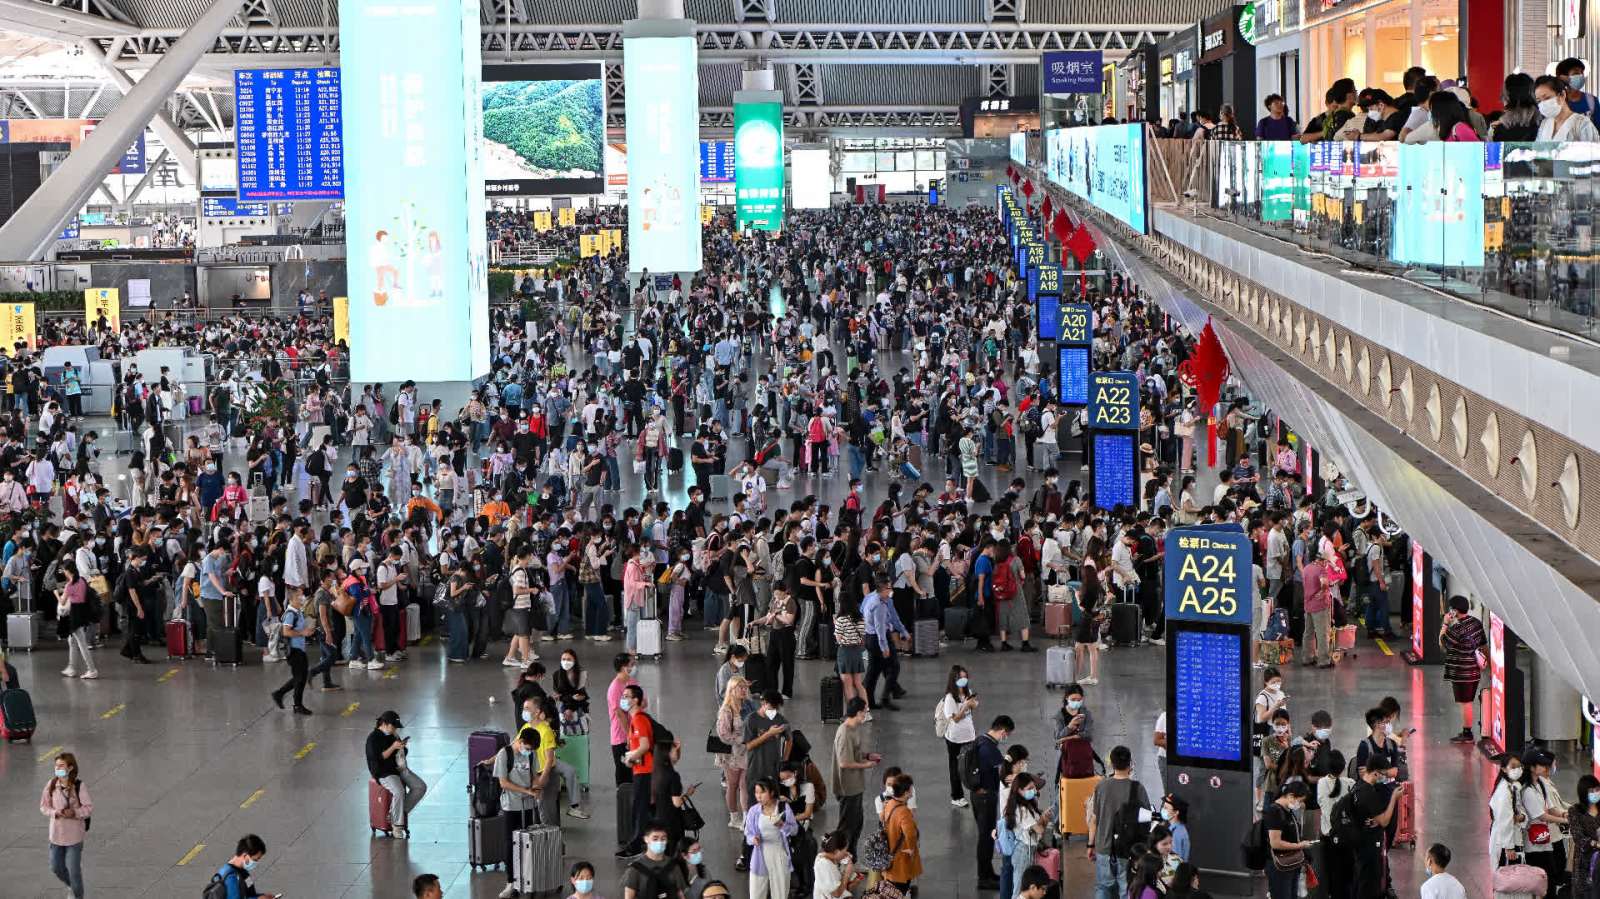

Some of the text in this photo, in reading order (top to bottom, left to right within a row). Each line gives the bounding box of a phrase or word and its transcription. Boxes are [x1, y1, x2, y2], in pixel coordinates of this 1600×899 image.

[1051, 61, 1094, 75] 吸烟室
[1029, 247, 1044, 255] A16
[1029, 256, 1044, 264] A17
[1040, 270, 1058, 281] A18
[1040, 282, 1058, 291] A19
[1062, 314, 1086, 327] A20
[1062, 328, 1086, 340] A21
[1096, 387, 1130, 405] A22
[1096, 406, 1130, 424] A23
[1179, 537, 1210, 549] 检票口
[1178, 554, 1237, 584] A24
[1179, 585, 1237, 616] A25
